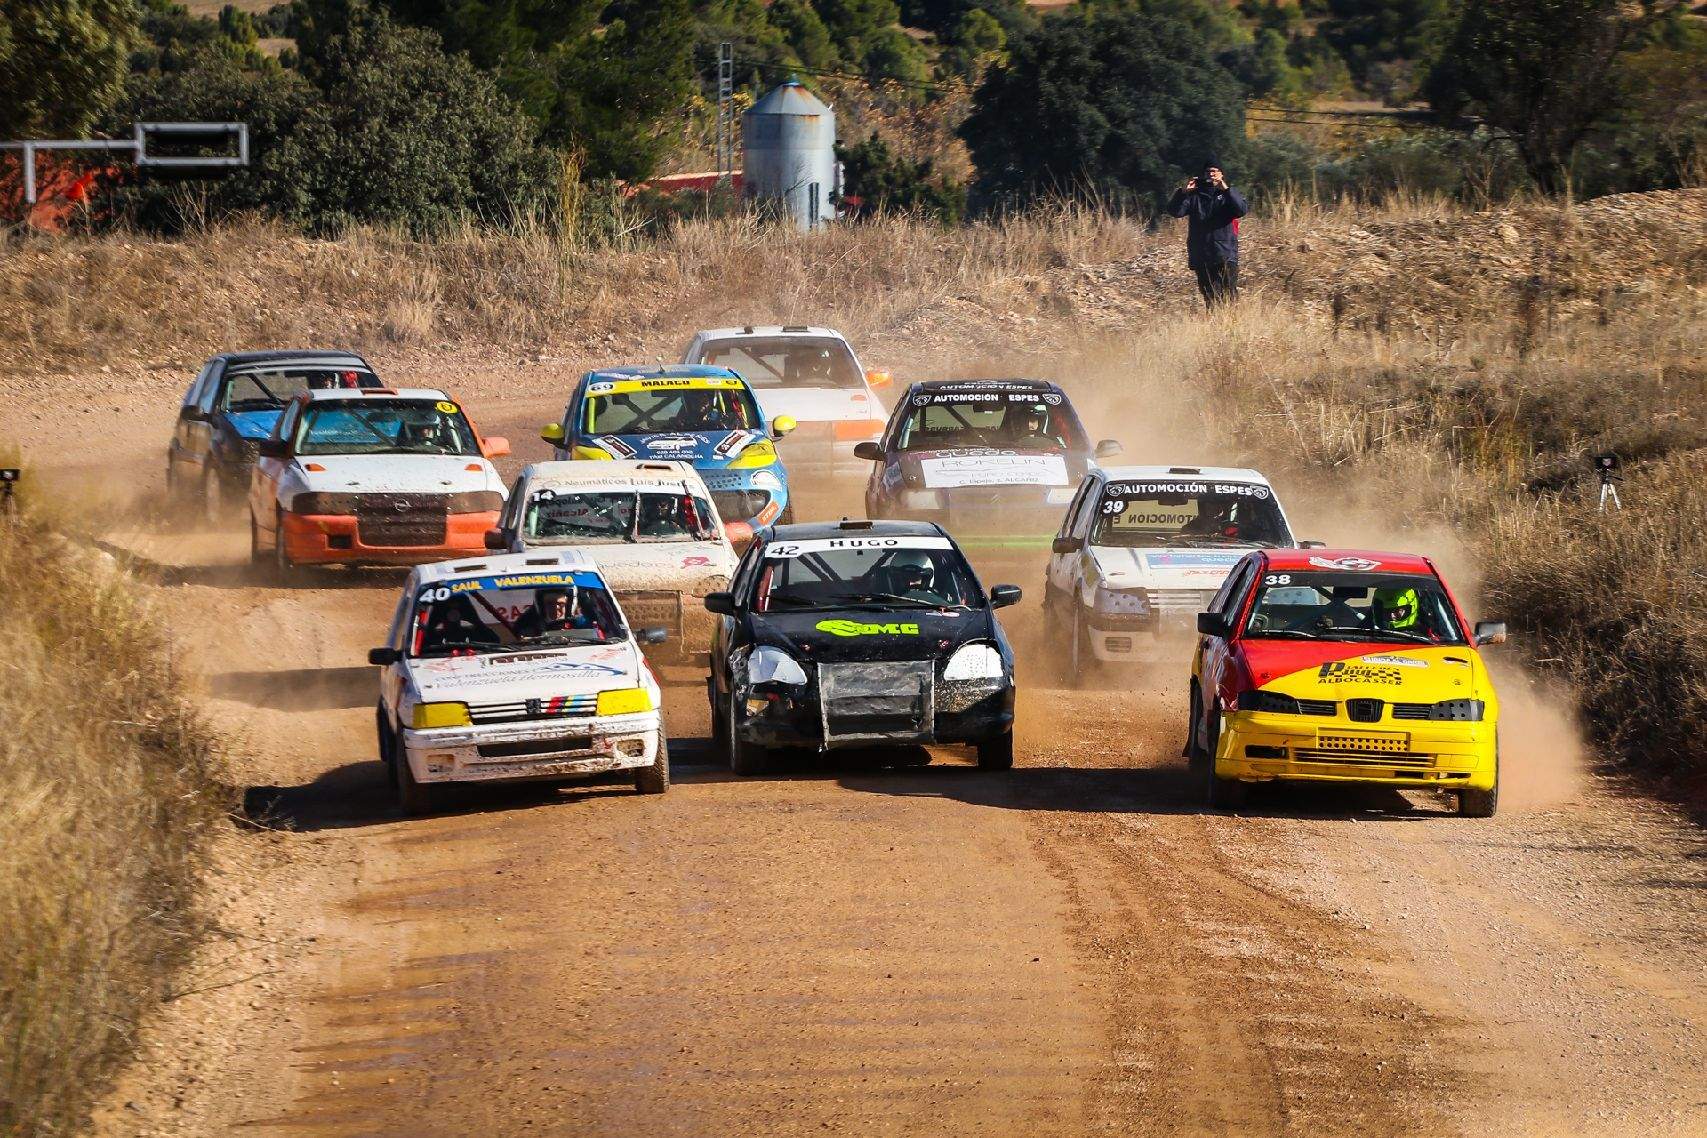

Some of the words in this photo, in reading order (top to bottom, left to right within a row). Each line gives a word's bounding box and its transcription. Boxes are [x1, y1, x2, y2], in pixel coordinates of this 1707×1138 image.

[933, 393, 999, 403] AUTOMOCIÓN
[1008, 393, 1040, 402] ESPES
[1124, 481, 1208, 495] AUTOMOCIÓN
[1214, 485, 1253, 496] ESPES
[1102, 500, 1125, 515] 39
[829, 539, 898, 548] HUGO
[770, 545, 800, 556] 42
[494, 575, 575, 588] VALENZUELA
[1264, 574, 1291, 585] 38
[419, 586, 451, 603] 40
[1318, 677, 1403, 686] ALBOCASSER
